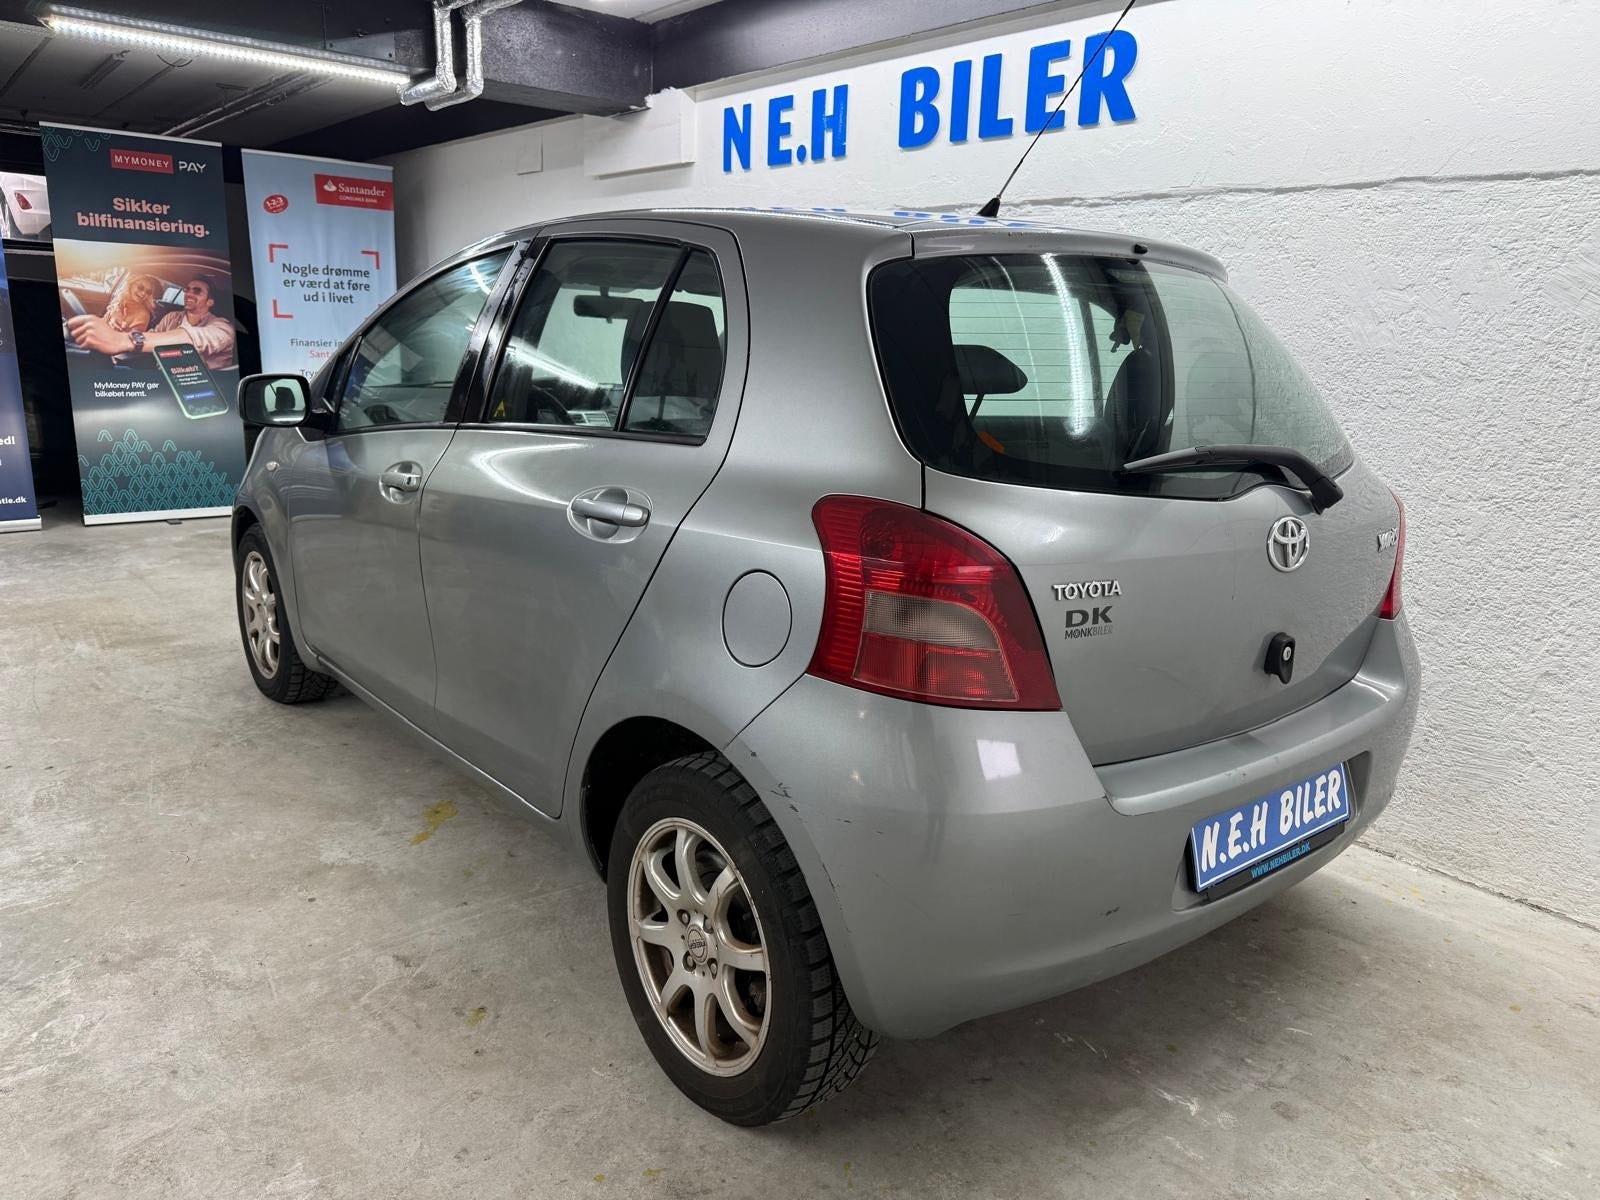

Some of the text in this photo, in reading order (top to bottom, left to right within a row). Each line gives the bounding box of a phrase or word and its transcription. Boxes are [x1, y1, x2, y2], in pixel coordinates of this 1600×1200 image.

[898, 29, 1138, 149] BILER
[114, 154, 206, 173] MYMONEY PAY
[338, 183, 386, 197] Santander
[113, 197, 171, 215] Sikker
[76, 212, 210, 238] bilfinansiering.
[282, 263, 370, 278] Nogle drømme
[283, 279, 371, 292] er værd at føre
[303, 291, 354, 304] ud i livet
[290, 338, 332, 348] Finansier
[309, 350, 332, 359] Sant
[94, 381, 131, 390] MyMoney
[147, 383, 160, 391] gør
[95, 390, 125, 398] bilkøbet
[1052, 580, 1122, 601] TOYOTA
[1065, 605, 1113, 628] DK
[1201, 769, 1341, 873] N.E.H BILER
